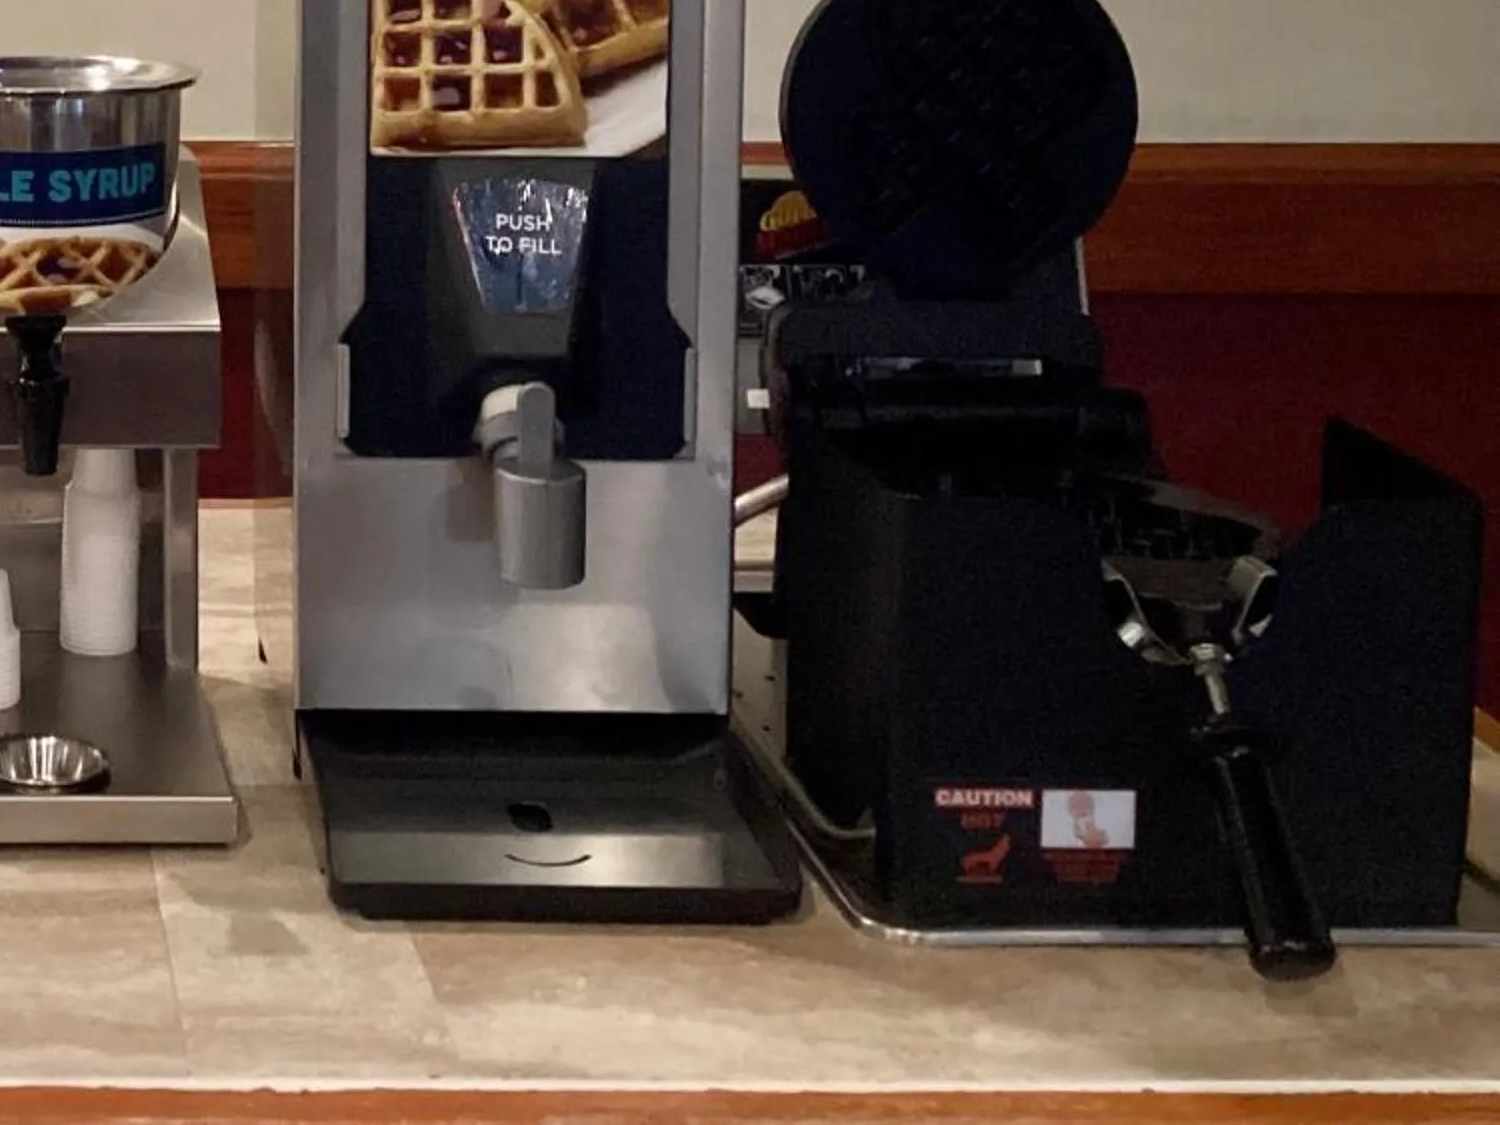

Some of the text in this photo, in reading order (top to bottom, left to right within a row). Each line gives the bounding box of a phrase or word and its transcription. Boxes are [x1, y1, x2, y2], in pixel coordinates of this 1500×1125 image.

[48, 162, 156, 203] SYRUP
[496, 213, 550, 231] PUSH
[484, 235, 562, 255] TO FILL
[935, 789, 1033, 807] CAUTION
